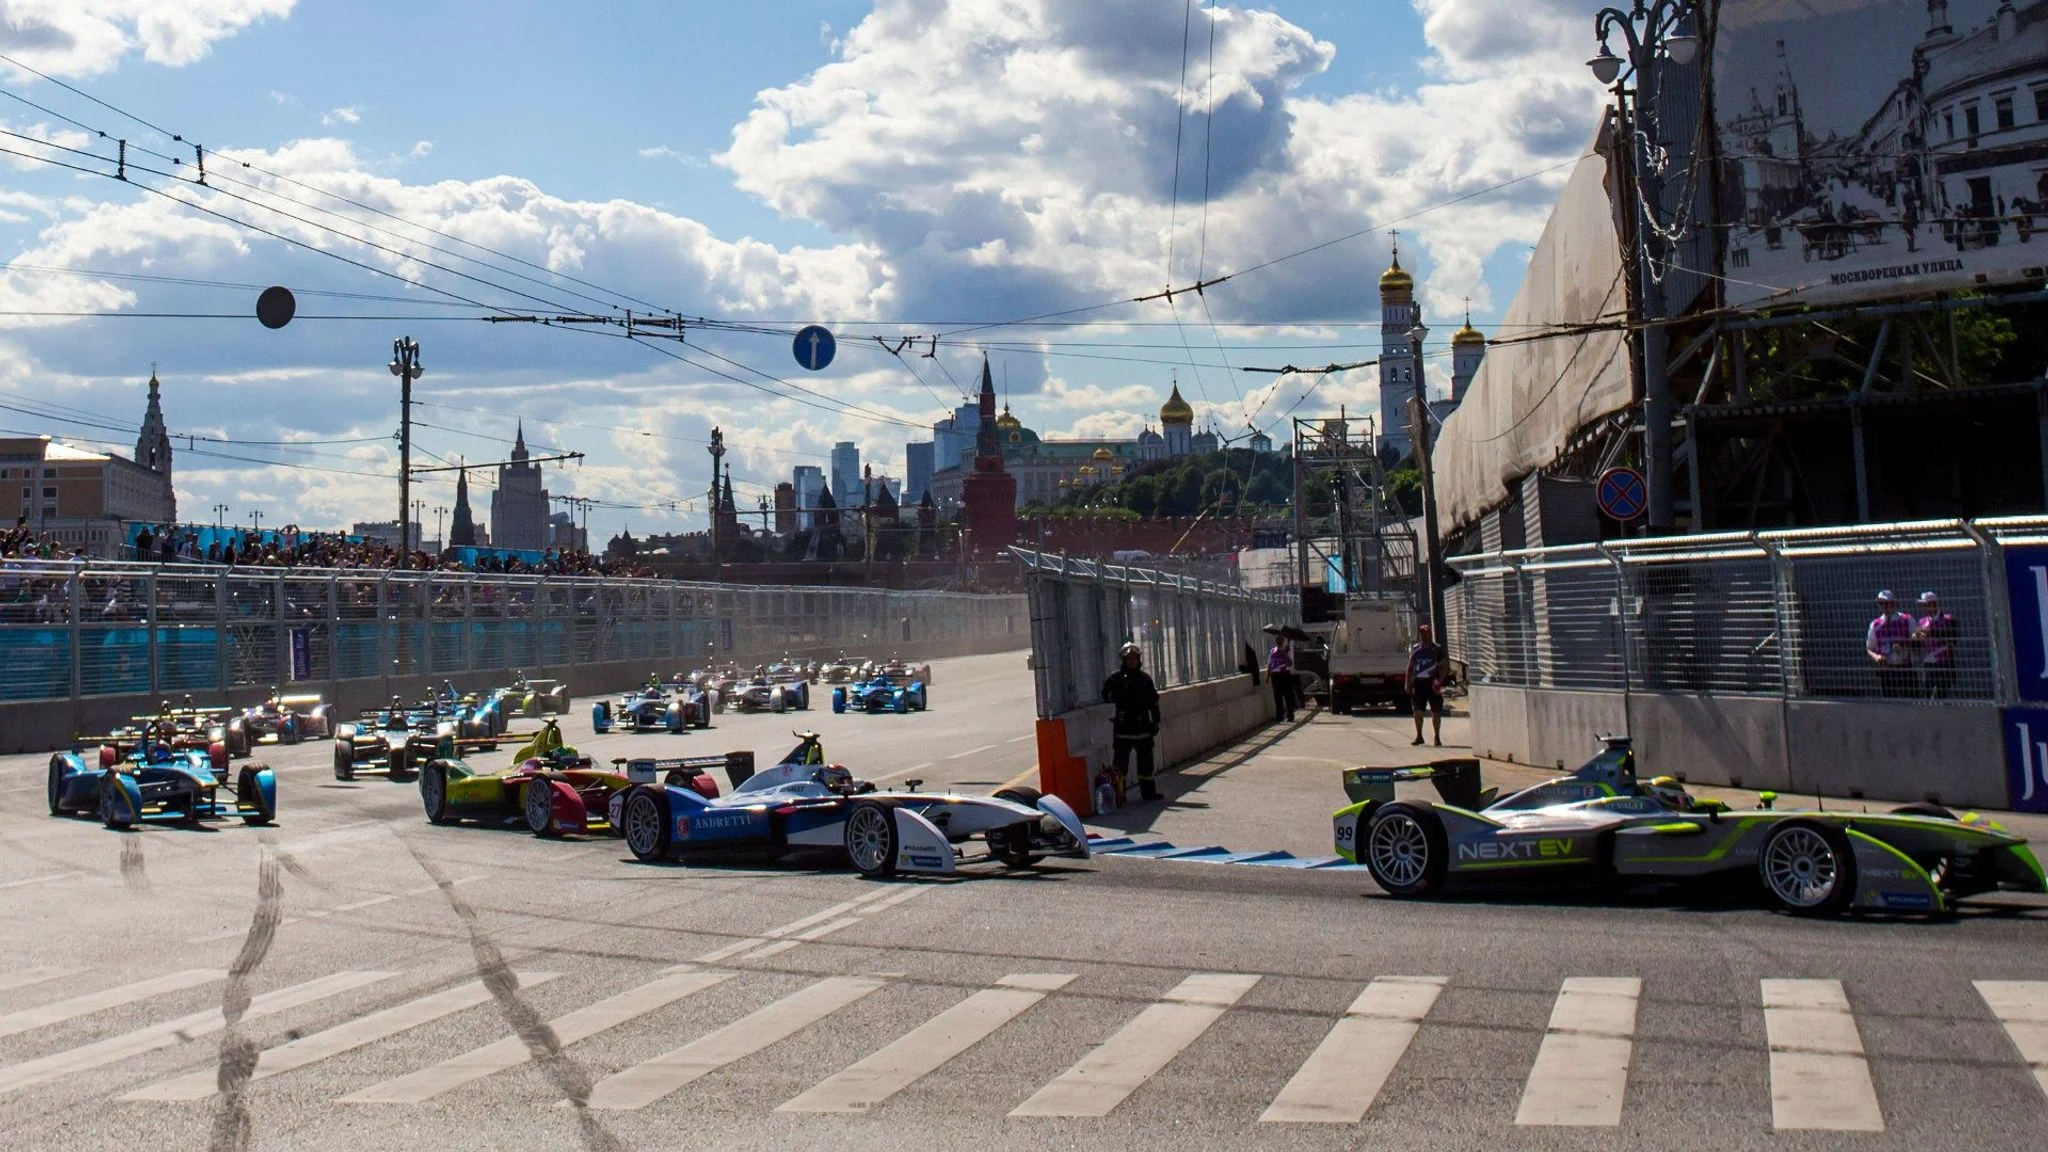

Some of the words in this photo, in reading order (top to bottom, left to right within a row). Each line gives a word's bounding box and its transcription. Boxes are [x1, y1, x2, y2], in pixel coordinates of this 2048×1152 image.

[1830, 263, 1921, 285] МОСКВОРЕЦКАЯ
[1921, 258, 1964, 274] УЛИЦА
[611, 803, 620, 818] 27
[695, 814, 752, 830] ANDRETTI
[1336, 826, 1353, 841] 99
[1457, 838, 1573, 860] NEXTEV
